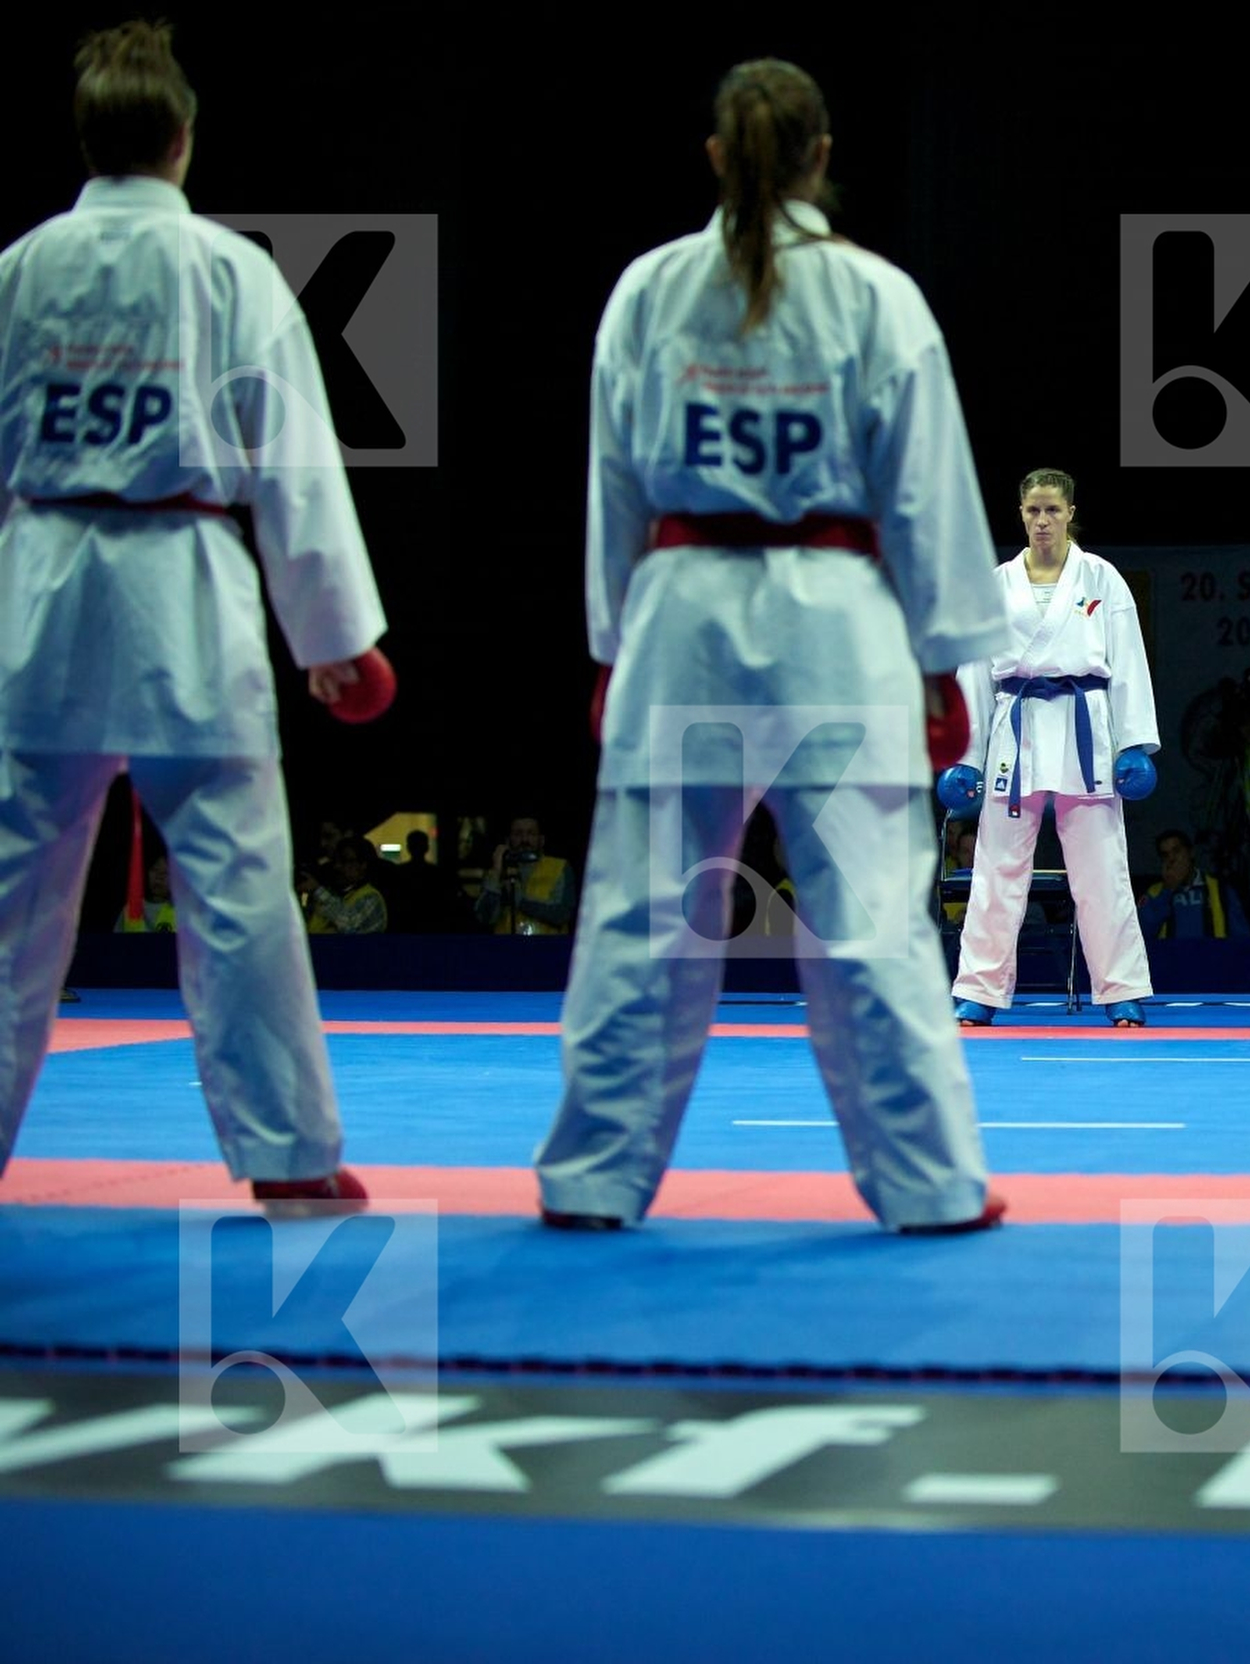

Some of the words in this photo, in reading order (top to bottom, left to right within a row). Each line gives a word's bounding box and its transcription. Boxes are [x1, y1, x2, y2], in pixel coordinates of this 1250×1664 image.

[42, 382, 173, 445] ESP
[684, 402, 823, 475] ESP
[1180, 571, 1226, 601] 20.
